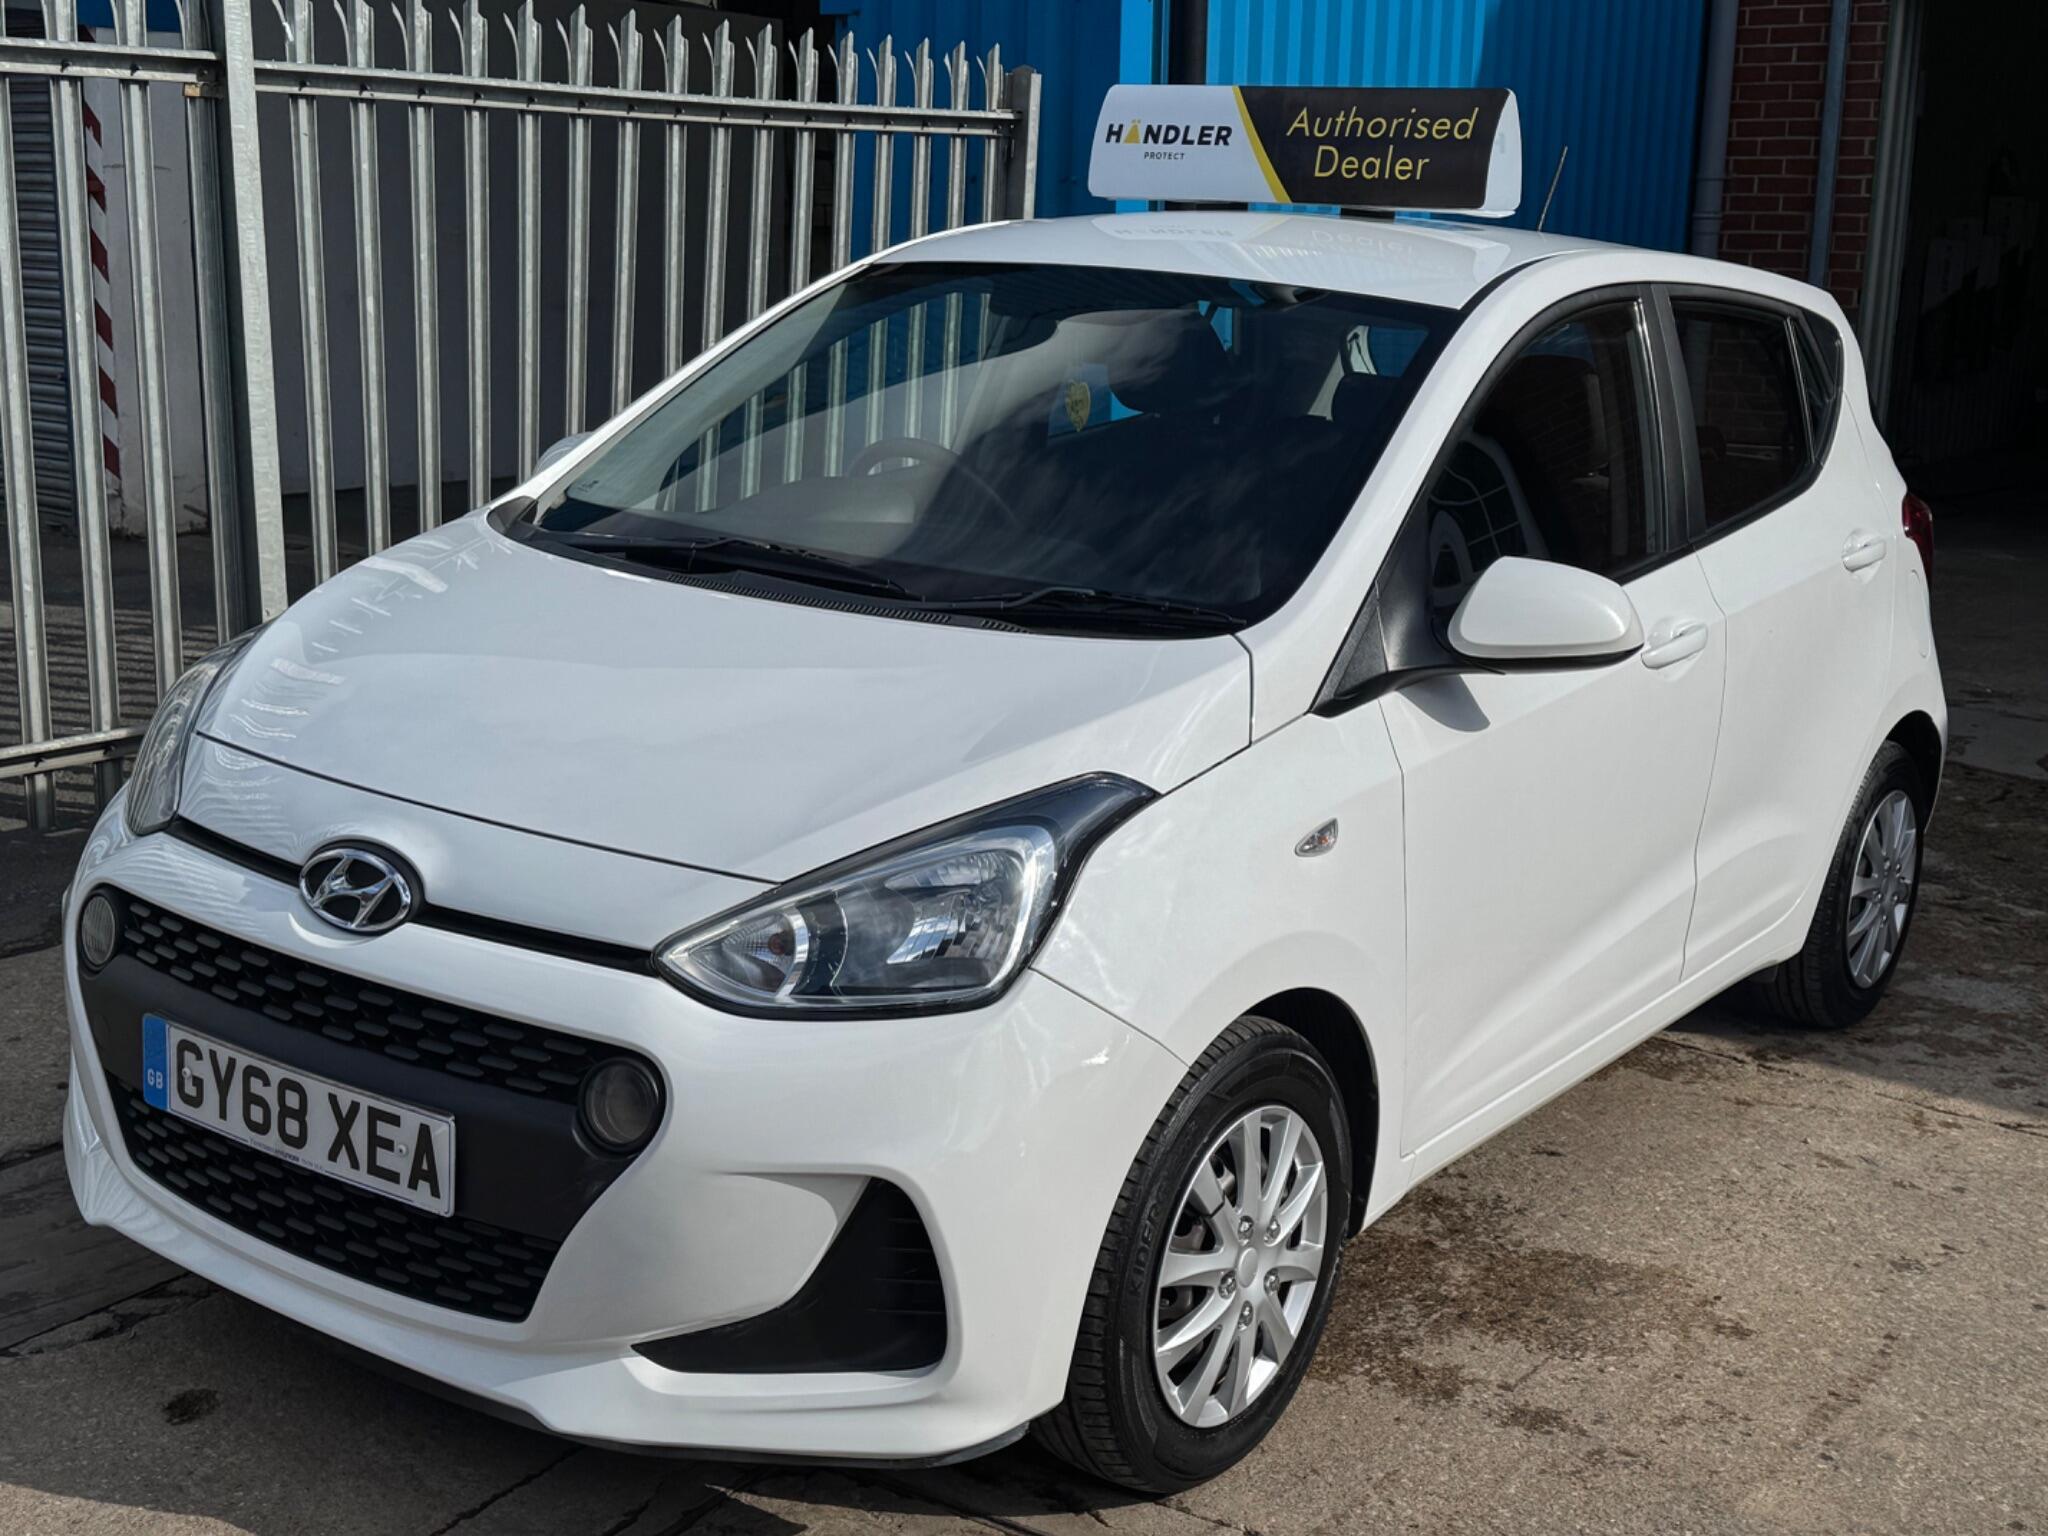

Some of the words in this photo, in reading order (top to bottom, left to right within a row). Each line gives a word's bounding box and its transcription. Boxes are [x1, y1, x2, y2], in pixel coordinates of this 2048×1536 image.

[1105, 119, 1233, 146] HÄNDLER
[1286, 105, 1480, 140] Authorised
[1143, 151, 1186, 161] PROTECT
[1314, 144, 1431, 181] Dealer
[147, 1068, 164, 1089] GB
[176, 1038, 308, 1150] GY68
[327, 1092, 441, 1200] XEA
